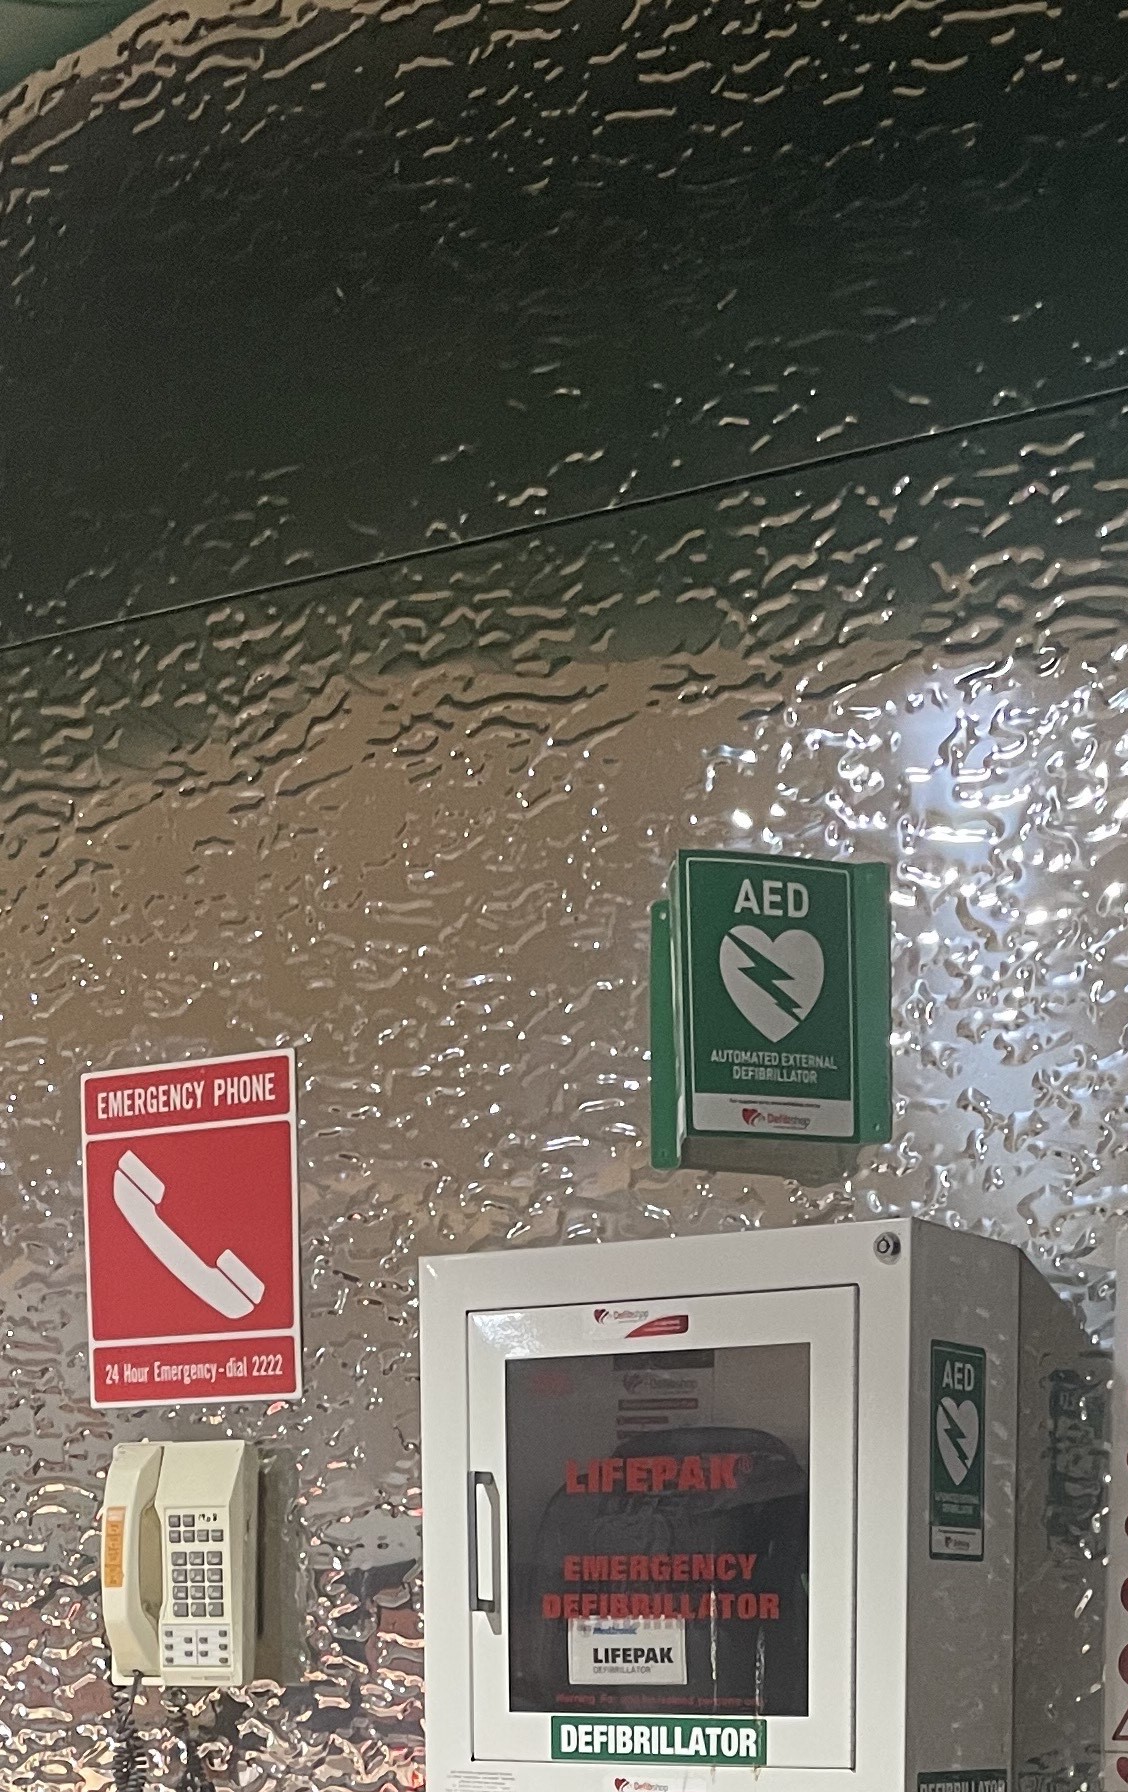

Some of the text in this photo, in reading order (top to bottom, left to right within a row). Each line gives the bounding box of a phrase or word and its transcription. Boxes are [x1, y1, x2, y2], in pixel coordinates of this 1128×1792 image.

[734, 878, 810, 919] AED
[711, 1049, 838, 1070] AUTOMATED EXTERNAL
[732, 1065, 818, 1084] DEFIBRILLATOR
[97, 1072, 276, 1120] EMERGENCY PHONE
[105, 1364, 119, 1385] 24
[123, 1362, 150, 1384] Hour
[252, 1353, 283, 1377] 2222
[942, 1359, 976, 1392] AED
[562, 1553, 758, 1582] EMERGENCY
[542, 1592, 780, 1620] DEFIBRILLATOR
[592, 1665, 652, 1675] DEFIBRILLATOR
[593, 1647, 674, 1664] LIFEPAK
[560, 1724, 757, 1757] DEFIBRILLATOR
